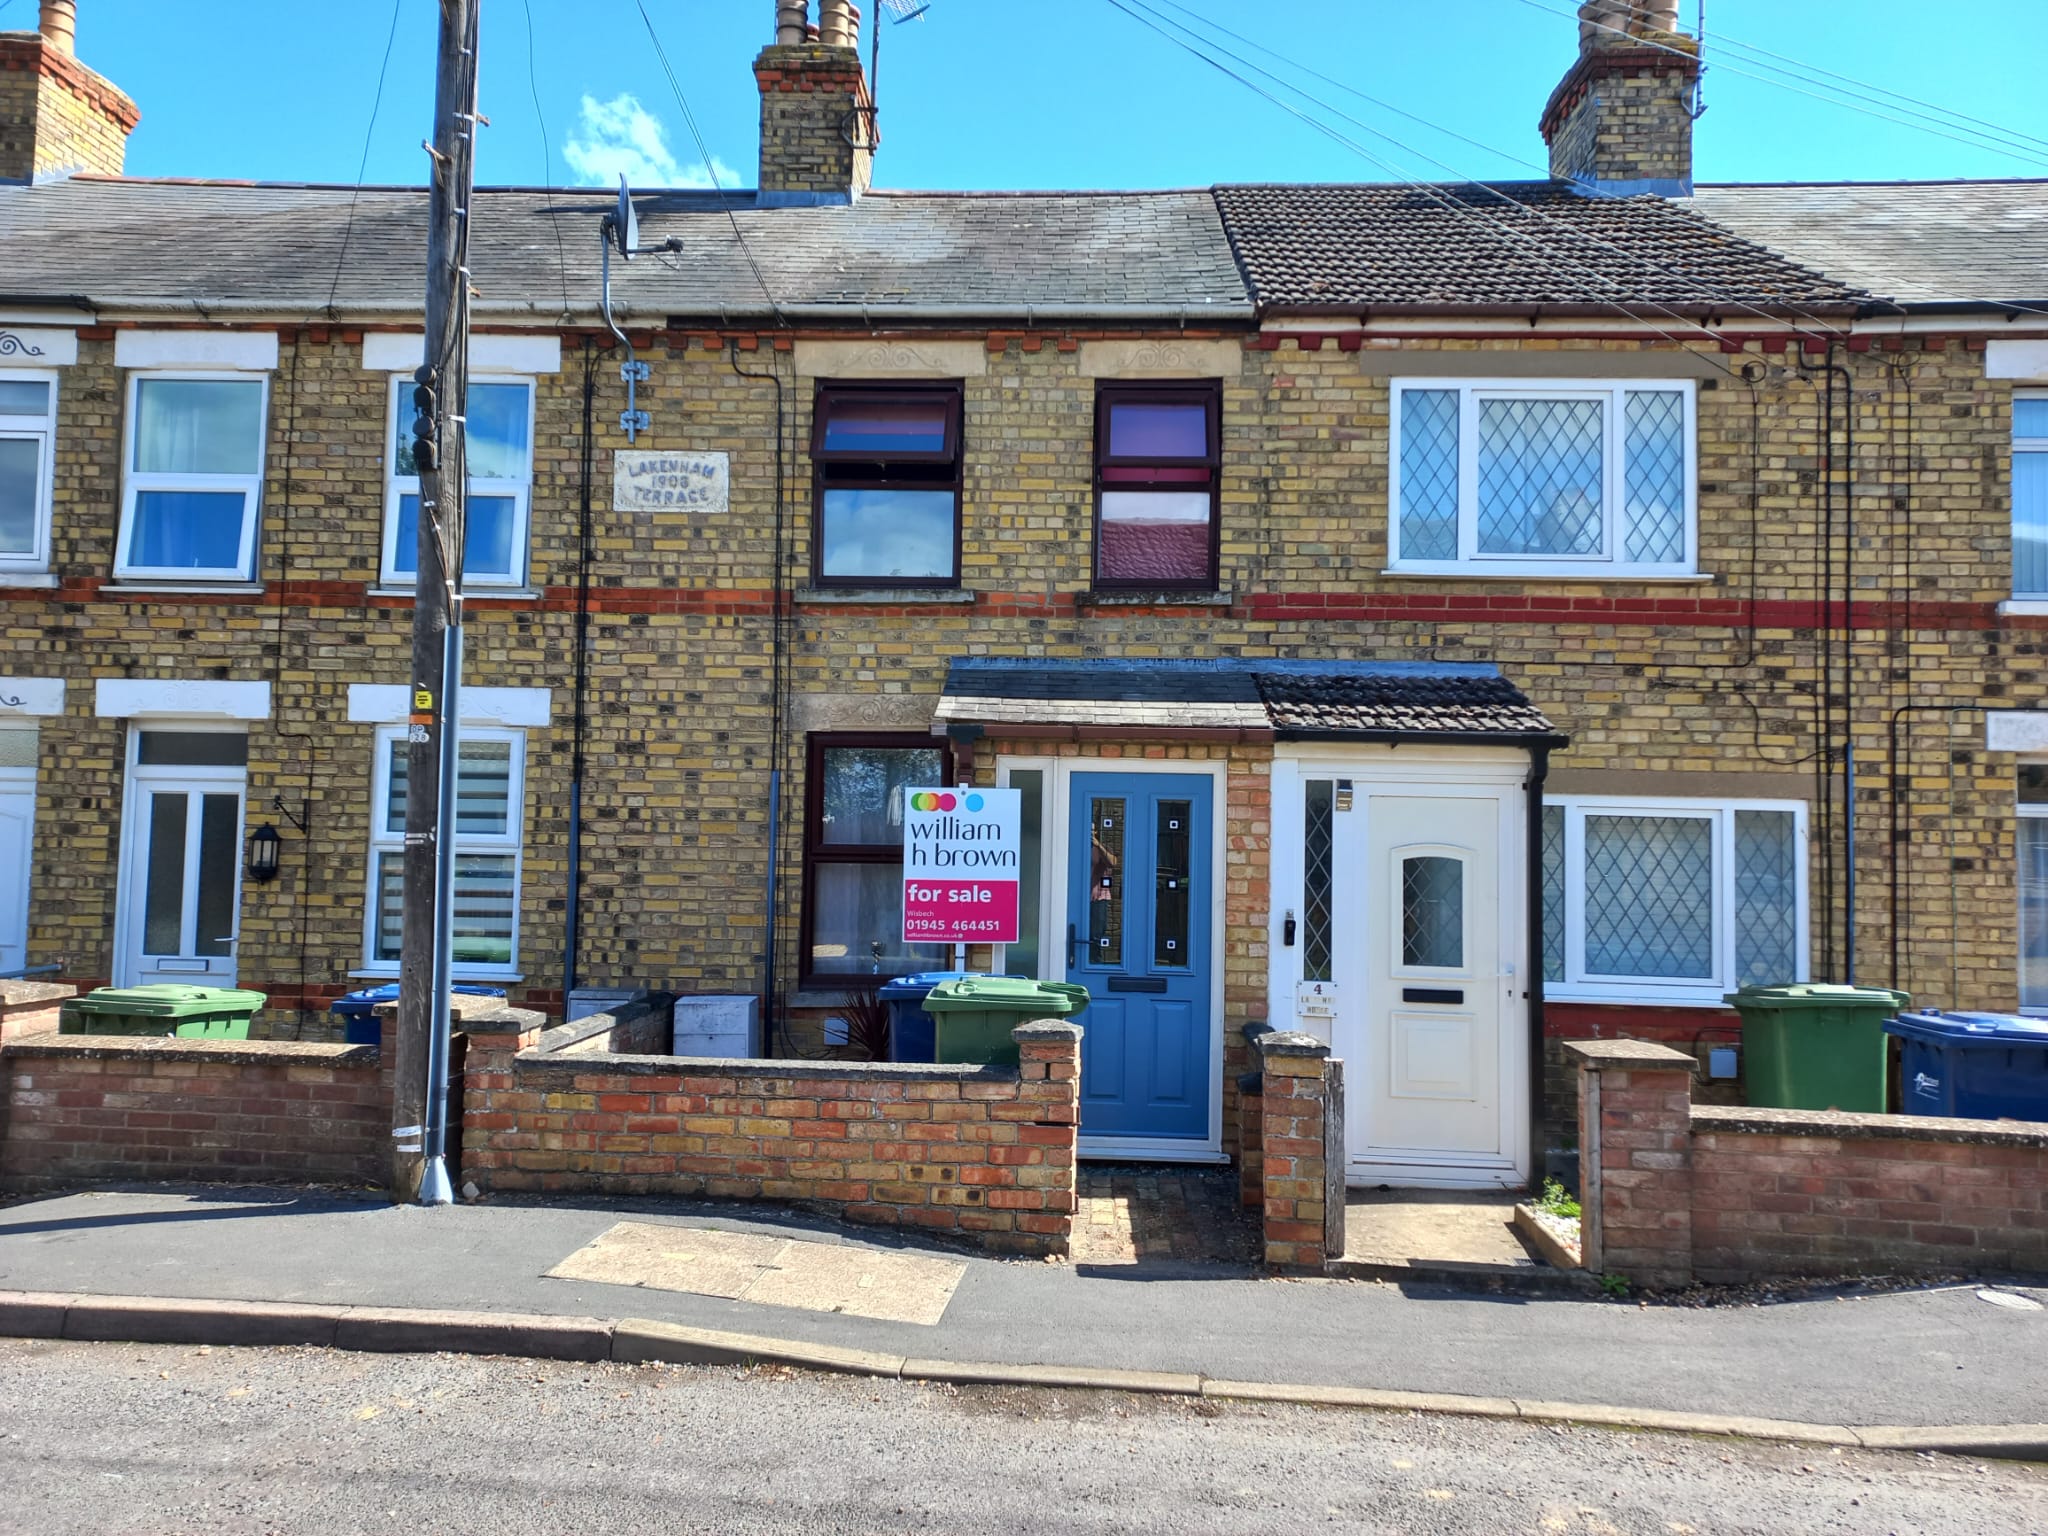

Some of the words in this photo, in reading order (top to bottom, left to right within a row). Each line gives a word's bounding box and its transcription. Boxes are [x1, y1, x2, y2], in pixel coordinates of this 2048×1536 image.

[628, 459, 716, 480] LAKENHAM
[633, 485, 710, 505] TERRACE
[911, 816, 1000, 840] william
[912, 843, 926, 866] h
[935, 843, 1016, 867] brown
[908, 884, 942, 902] for
[948, 885, 992, 902] sale
[907, 919, 945, 930] 01945
[952, 920, 1000, 931] 464451
[1313, 984, 1323, 995] 4
